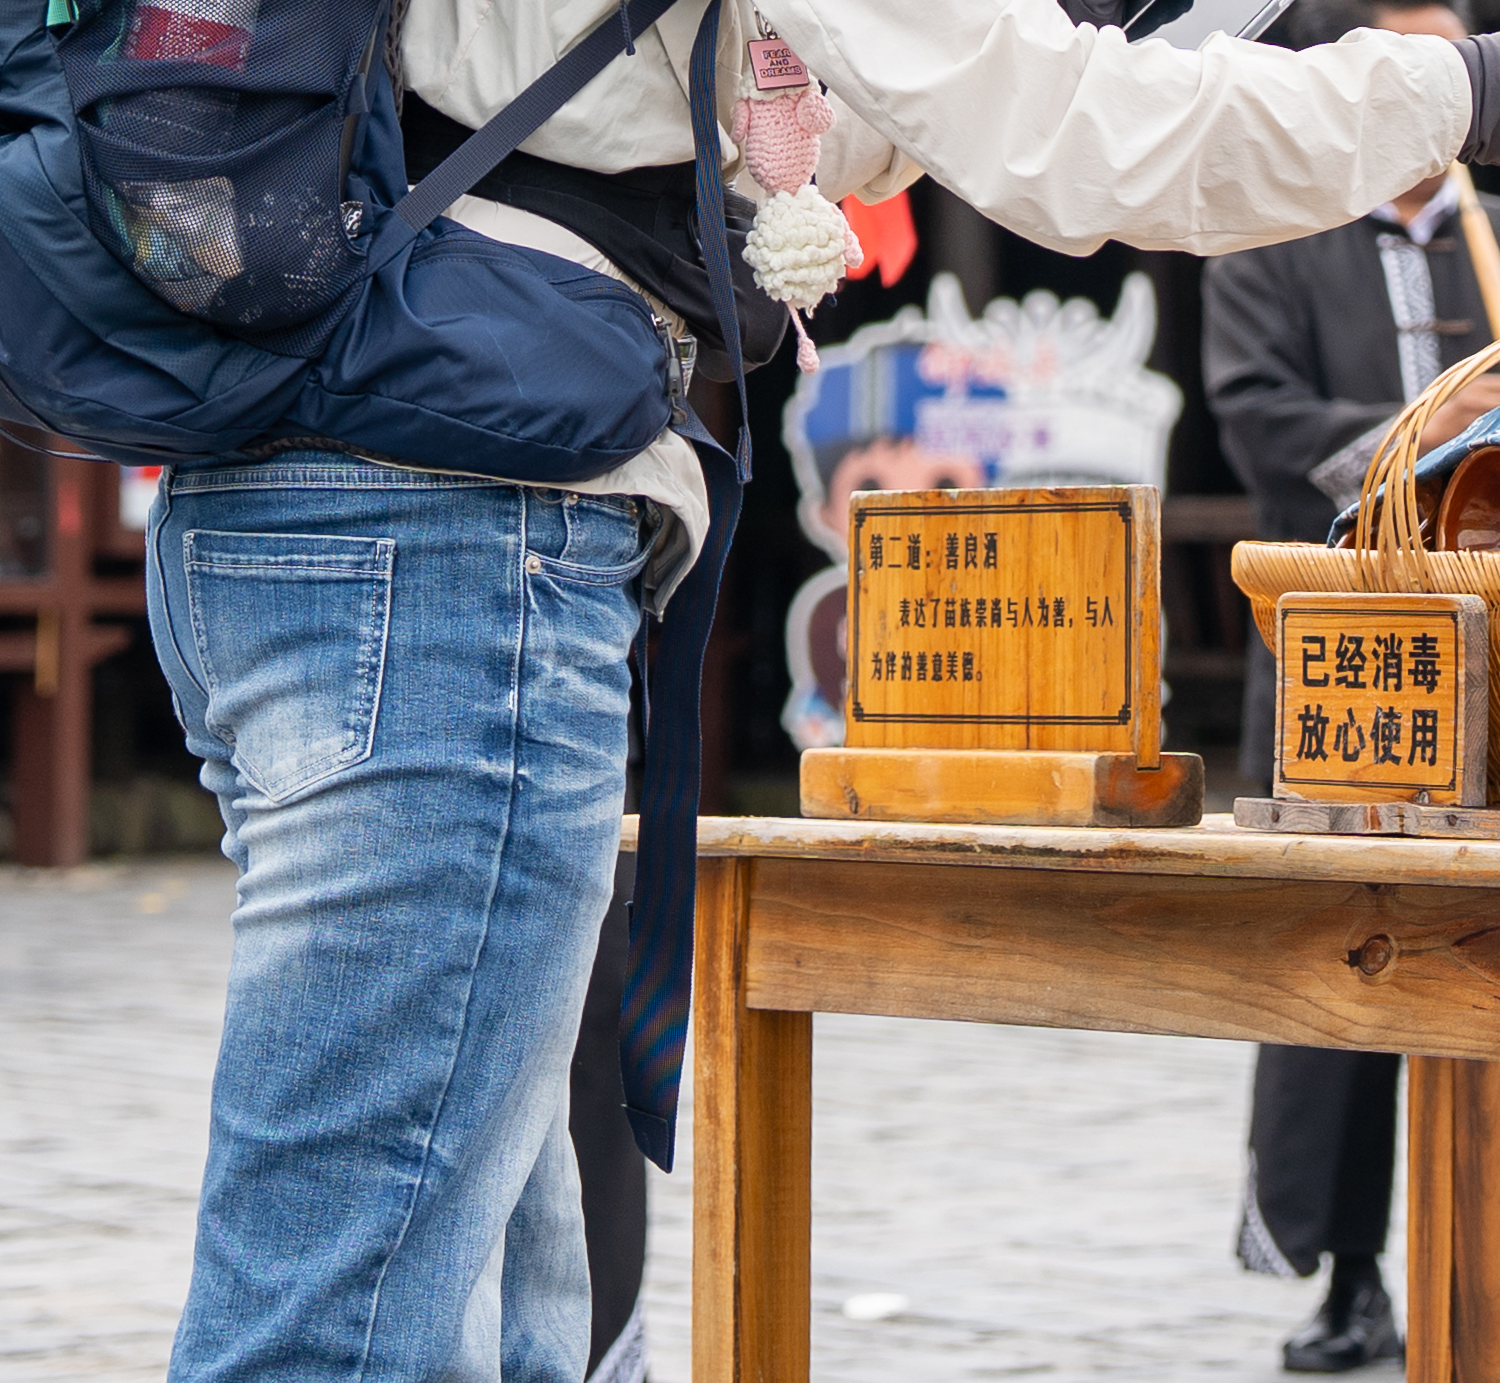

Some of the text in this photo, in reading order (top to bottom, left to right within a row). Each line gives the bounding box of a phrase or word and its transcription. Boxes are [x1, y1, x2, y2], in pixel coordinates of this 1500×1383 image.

[763, 48, 791, 59] FEAR
[770, 58, 789, 67] AND
[760, 65, 802, 78] DREAMS
[870, 532, 998, 570] 第二道：善良酒
[899, 596, 1114, 628] 表达了苗族崇尚与人为善，与人
[1302, 632, 1442, 694] 已经消毒
[1296, 703, 1438, 766] 放心使用
